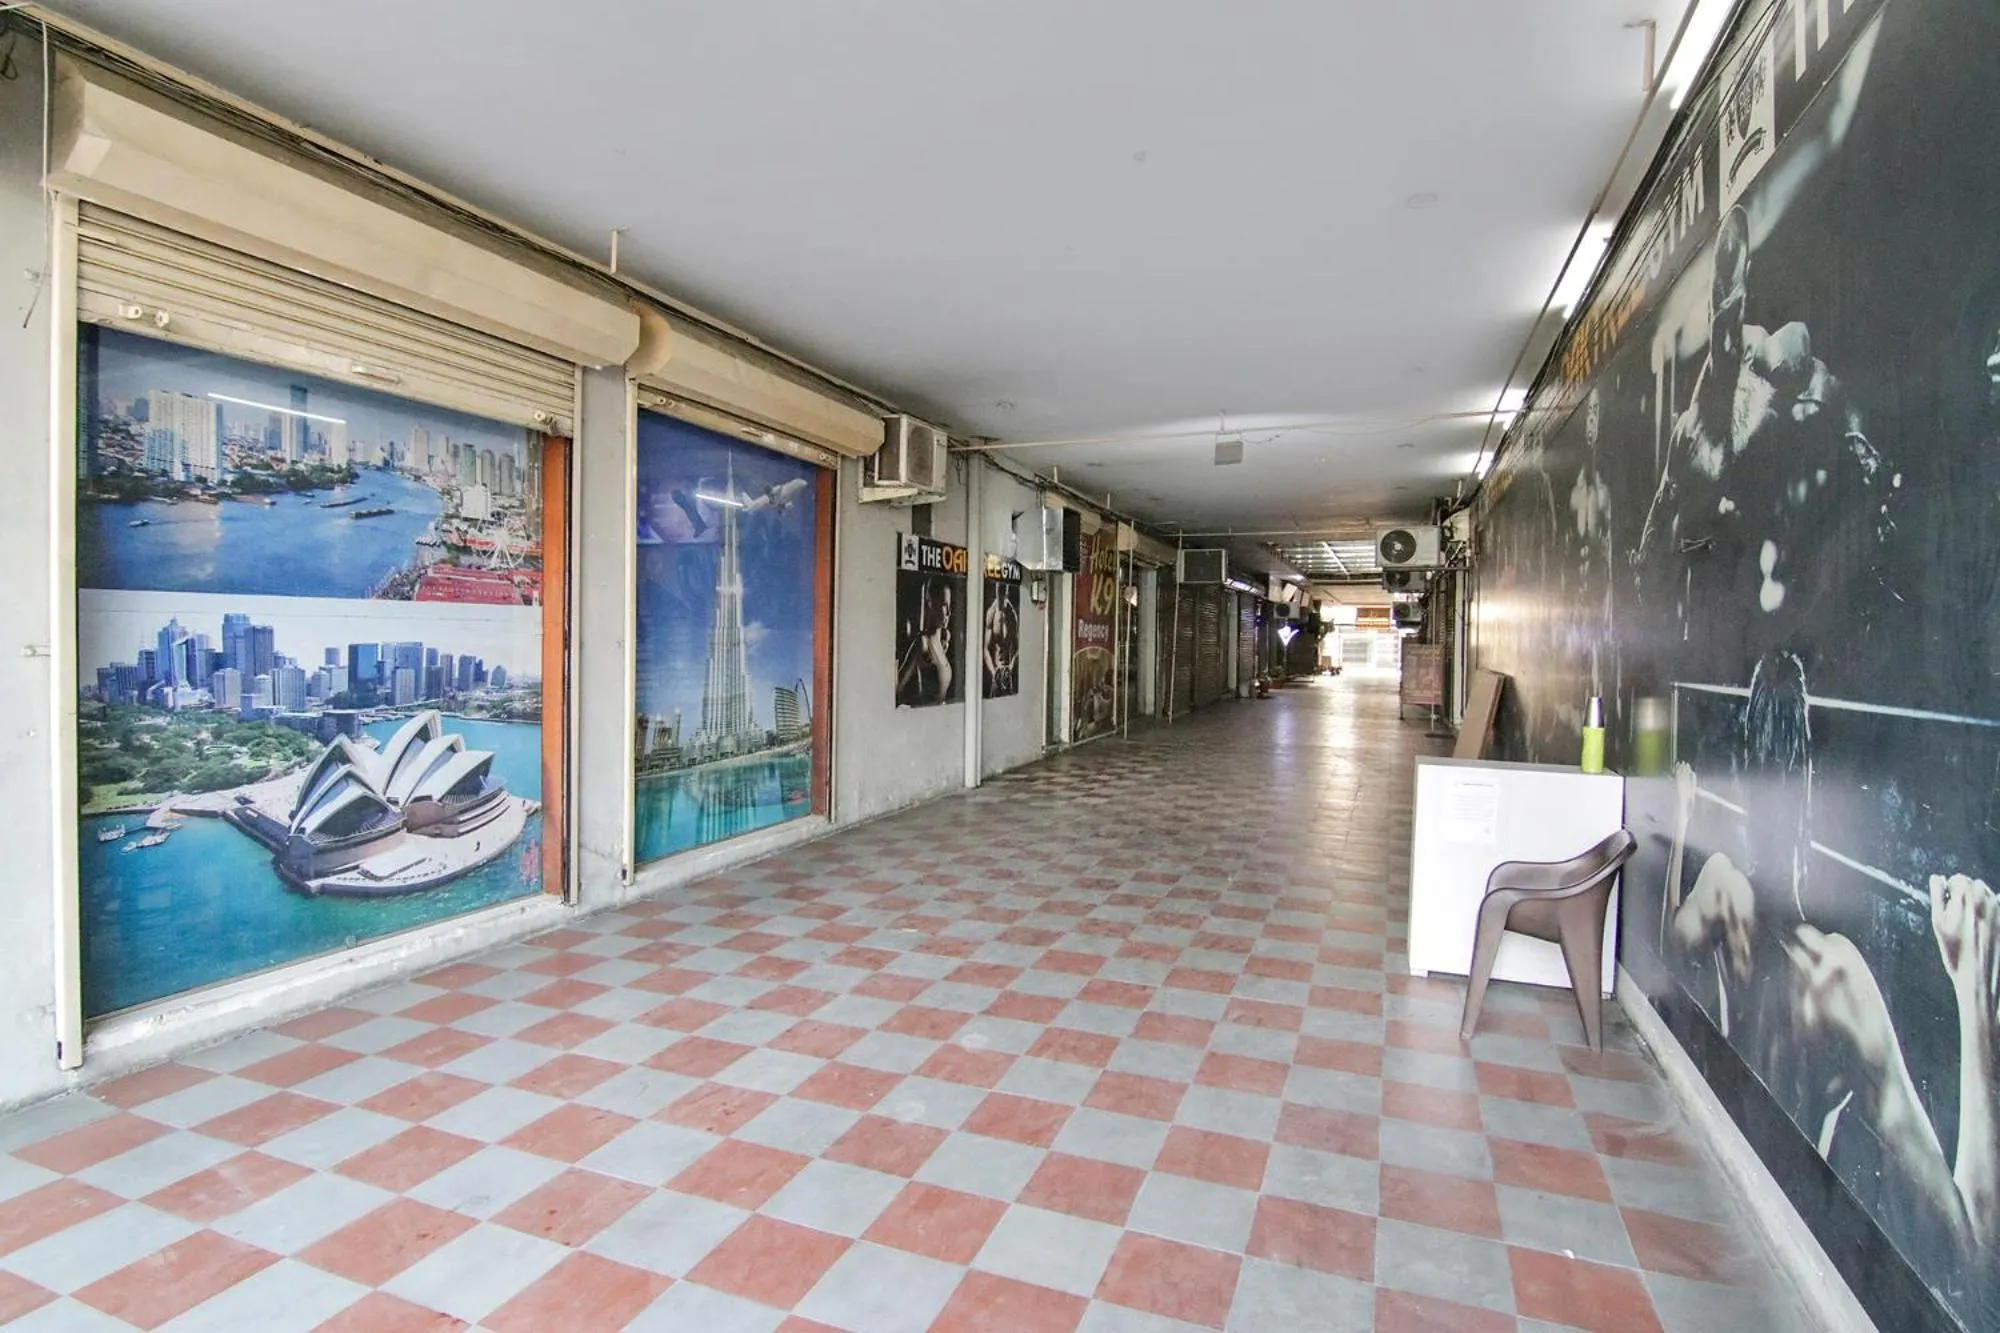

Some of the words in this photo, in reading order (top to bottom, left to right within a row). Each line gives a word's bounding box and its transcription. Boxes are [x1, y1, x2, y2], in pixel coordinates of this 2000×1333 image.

[921, 545, 942, 569] THE
[1090, 573, 1115, 615] K9
[1078, 618, 1109, 642] Regency
